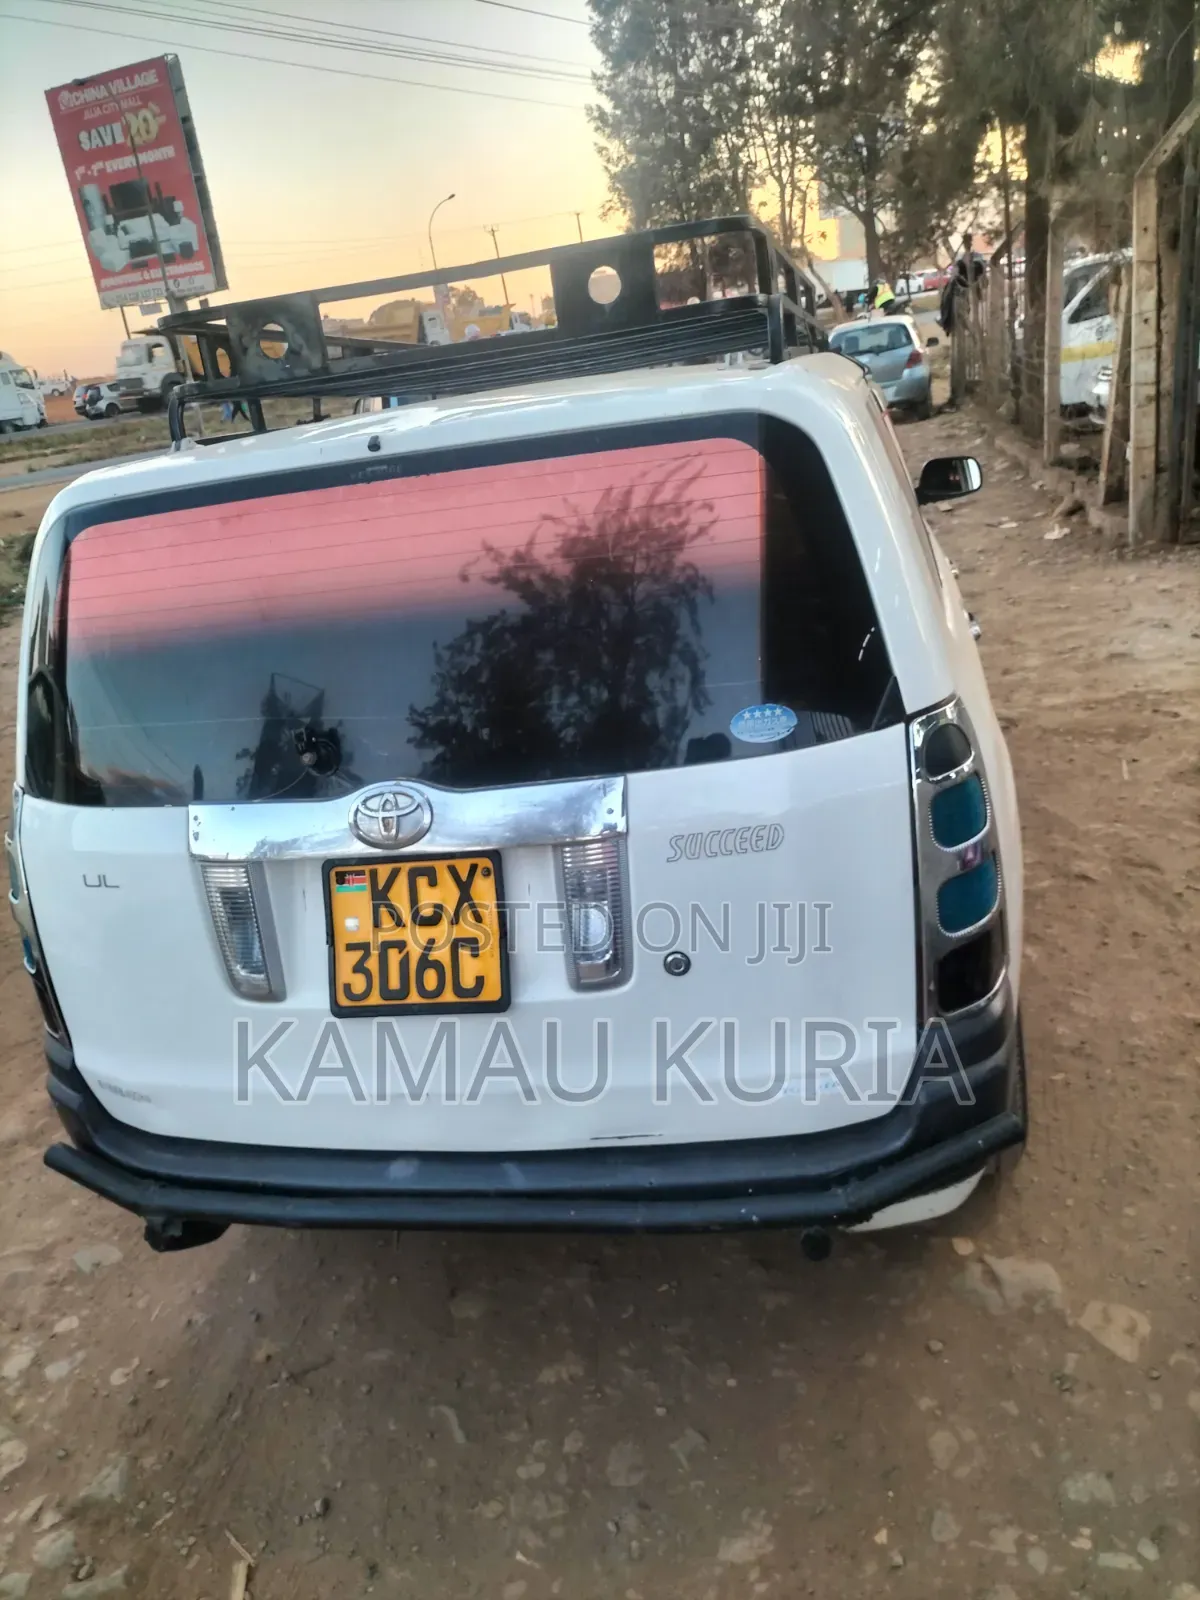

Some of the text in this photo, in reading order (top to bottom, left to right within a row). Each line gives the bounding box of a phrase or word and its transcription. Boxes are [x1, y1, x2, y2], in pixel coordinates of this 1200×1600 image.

[72, 69, 159, 107] CHINA VILLAGE
[78, 122, 125, 152] SAVE
[666, 823, 785, 863] SUCCEED
[82, 874, 120, 888] UL
[369, 863, 483, 928] KCX
[343, 937, 485, 1001] 306C
